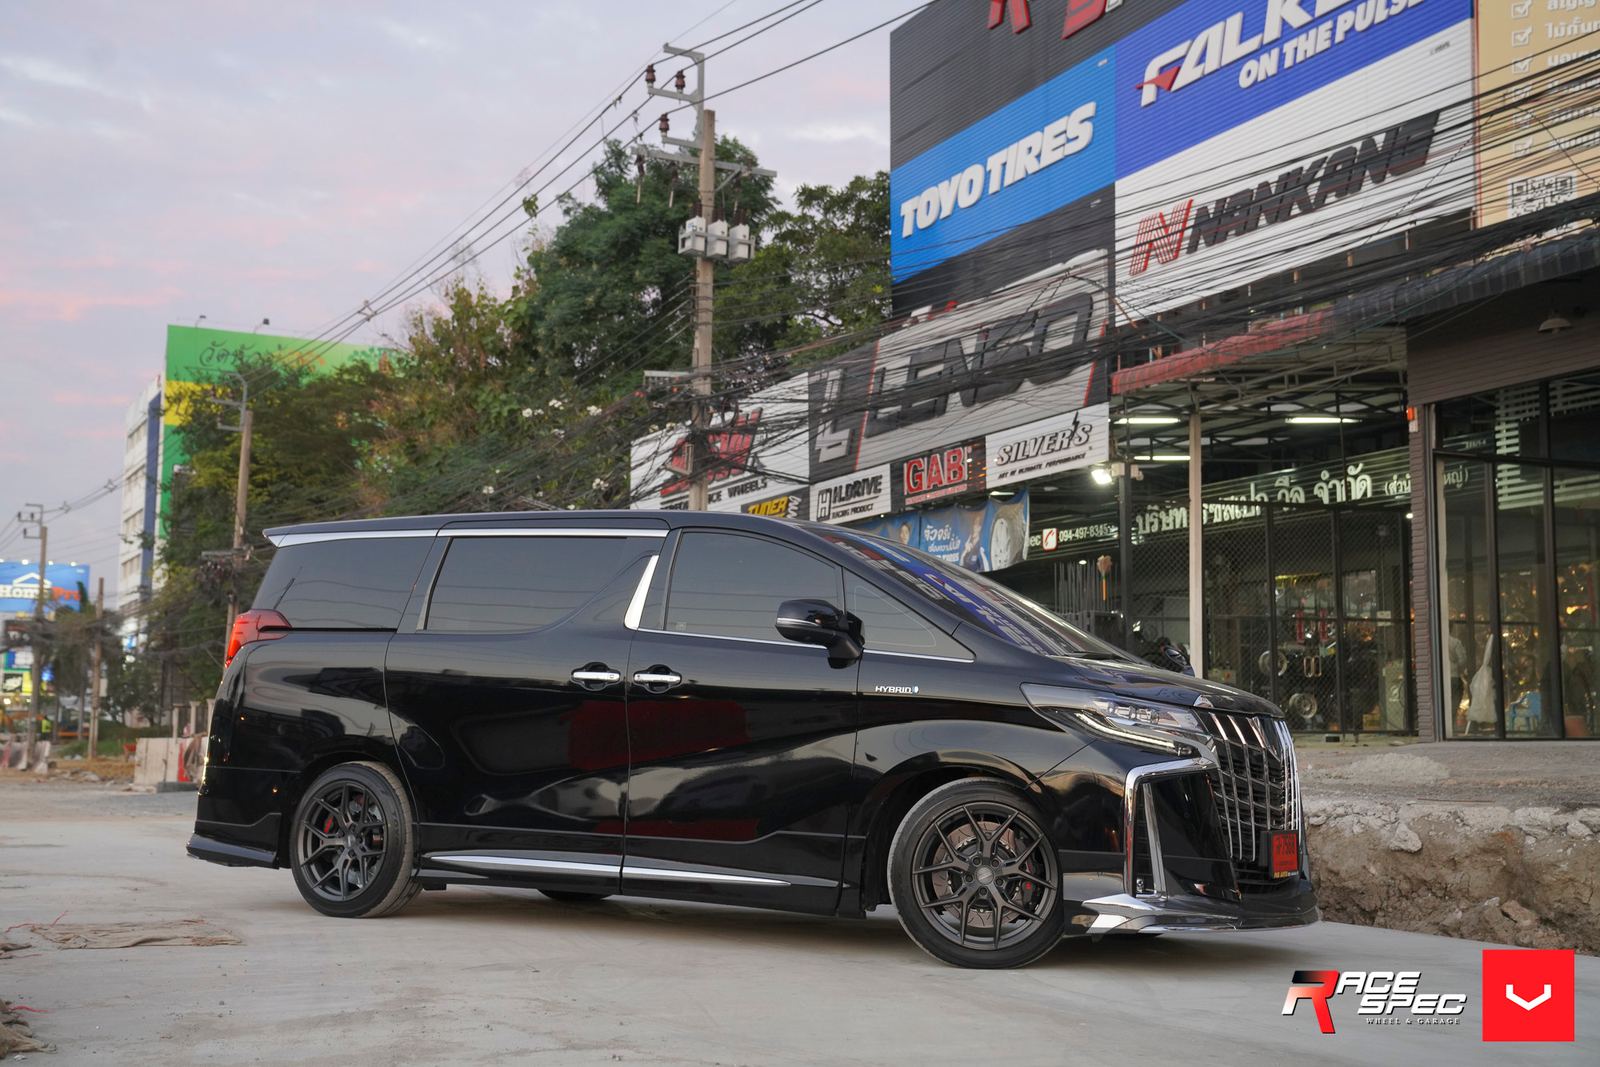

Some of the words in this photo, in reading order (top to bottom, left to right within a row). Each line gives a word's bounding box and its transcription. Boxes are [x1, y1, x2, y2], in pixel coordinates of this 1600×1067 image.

[1238, 47, 1279, 89] ON
[1283, 20, 1334, 69] THE
[900, 163, 985, 239] TOYO
[986, 101, 1097, 195] TIRES
[1186, 112, 1441, 255] NANKANG
[727, 476, 768, 499] WHEELS
[904, 446, 969, 496] GAB
[1314, 462, 1373, 505] จำกัด
[748, 496, 789, 516] TUNER
[875, 686, 912, 694] HYBRID
